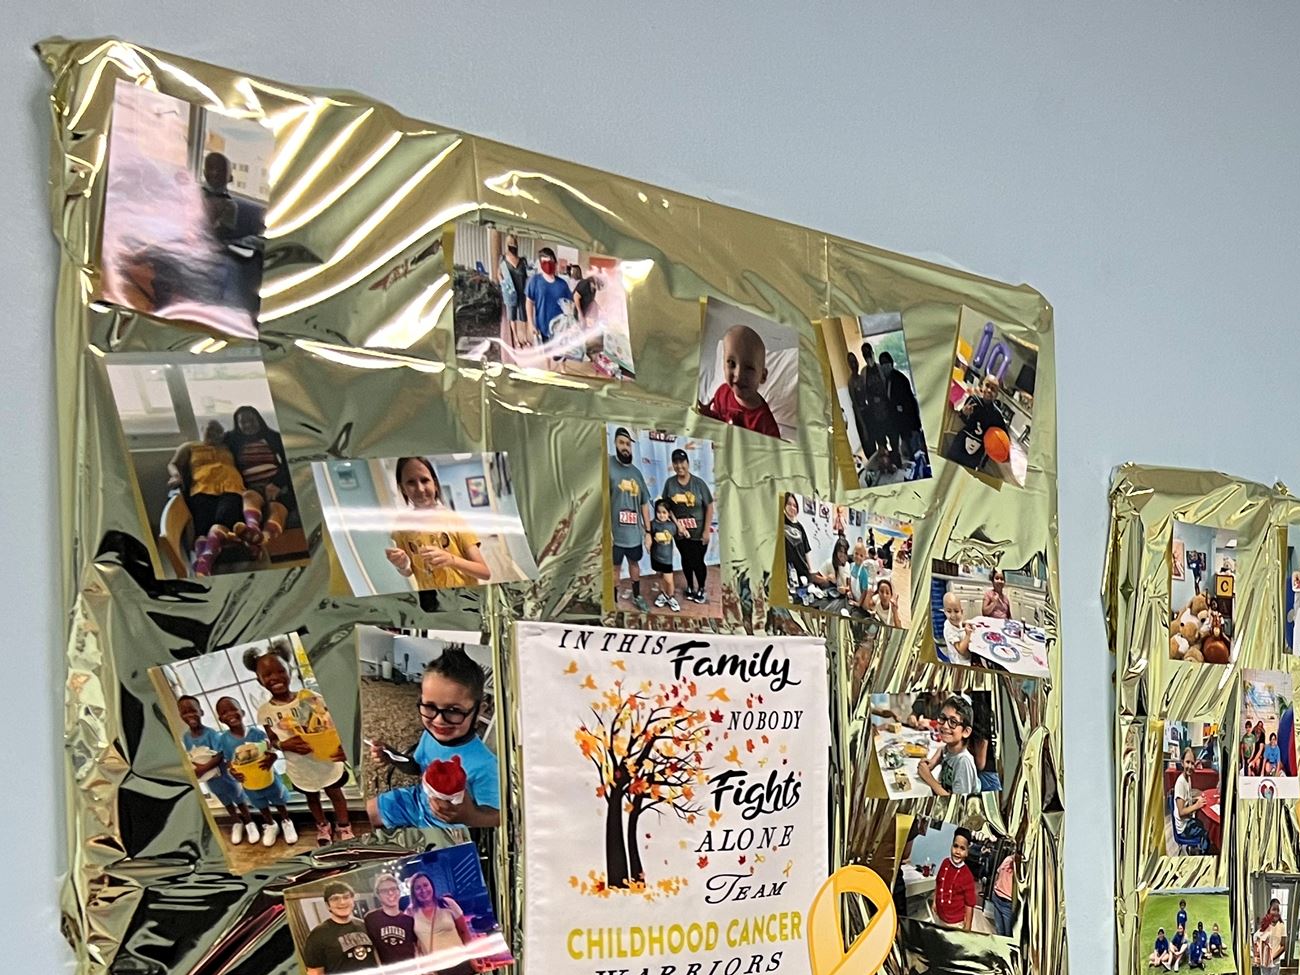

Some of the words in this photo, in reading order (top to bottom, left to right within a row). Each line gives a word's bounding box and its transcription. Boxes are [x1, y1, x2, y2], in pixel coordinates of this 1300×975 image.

[1220, 580, 1229, 592] C
[558, 629, 594, 650] IN
[599, 633, 667, 655] THIS
[666, 640, 802, 691] Family
[727, 709, 804, 732] NOBODY
[709, 769, 802, 818] Fights
[695, 824, 794, 854] ALONE
[567, 921, 719, 961] CHILDHOOD
[726, 910, 802, 948] CANCER
